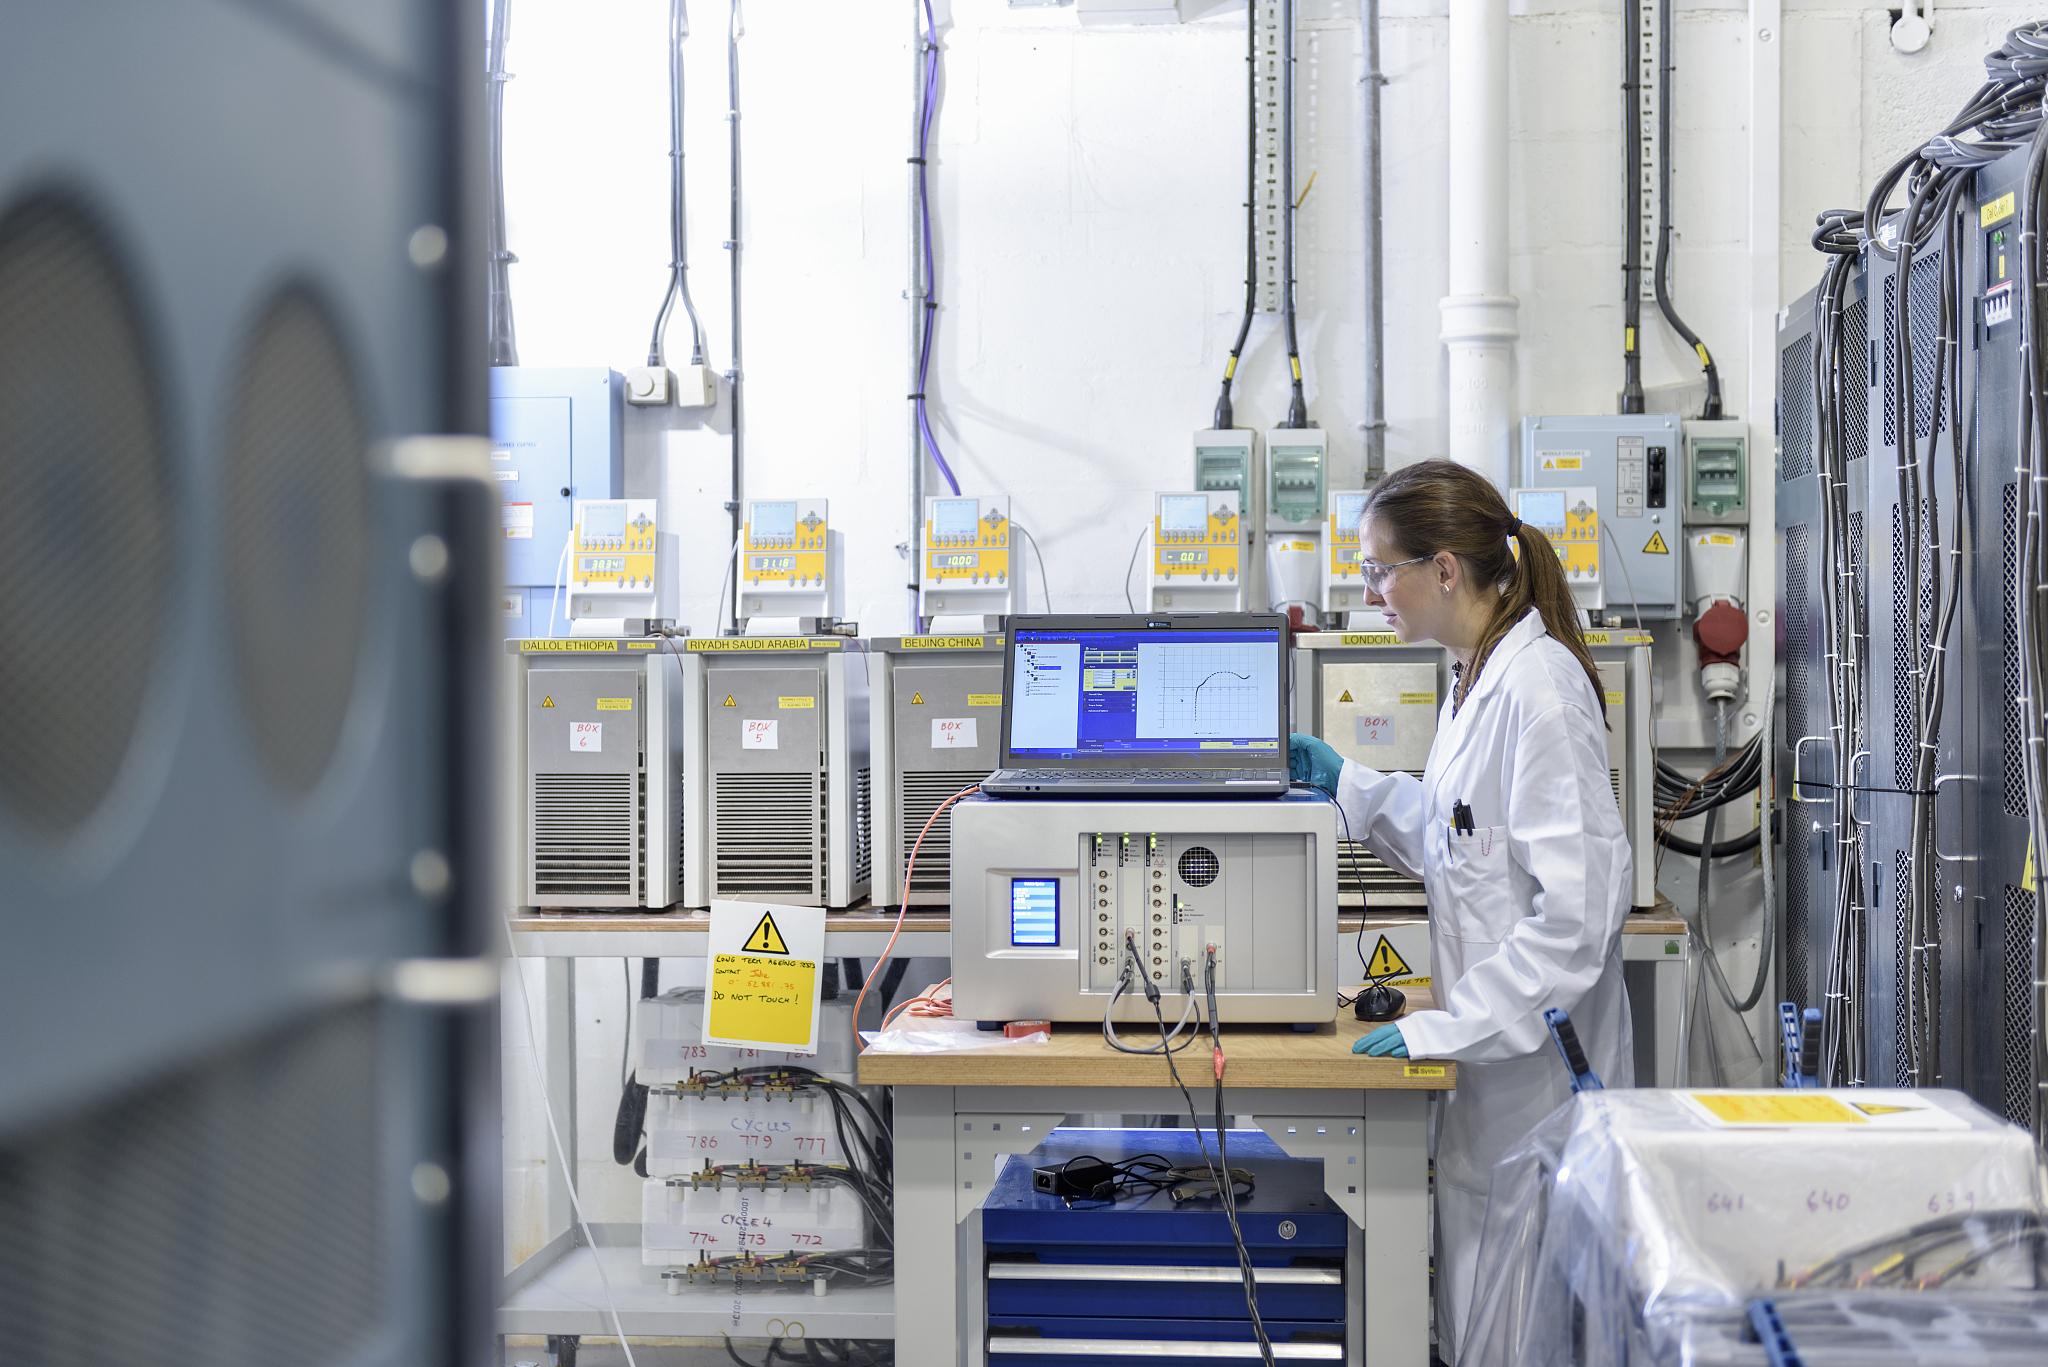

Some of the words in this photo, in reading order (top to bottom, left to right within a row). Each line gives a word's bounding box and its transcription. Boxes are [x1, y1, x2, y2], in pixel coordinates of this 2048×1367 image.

[690, 641, 729, 649] RIYADH
[732, 640, 765, 649] SAUDI
[768, 640, 806, 648] ARABIA
[905, 638, 945, 647] BEIJING
[948, 638, 982, 647] CHINA
[1344, 636, 1390, 644] LONDON
[523, 641, 562, 650] DALLOL
[565, 641, 614, 650] ETHIOPIA
[748, 721, 773, 732] BOX
[941, 722, 963, 730] BOX
[1364, 718, 1389, 727] BOX
[577, 723, 600, 733] BOX
[756, 734, 763, 742] 5
[947, 732, 955, 744] 4
[1371, 730, 1378, 740] 2
[580, 737, 586, 747] 6
[713, 991, 724, 1000] DO
[759, 995, 790, 1003] TOUCH
[681, 1046, 707, 1060] 783
[687, 1136, 717, 1148] 786
[739, 1135, 772, 1148] 779
[794, 1137, 826, 1155] 777
[1707, 1192, 1744, 1213] 641
[1806, 1189, 1850, 1213] 640
[1928, 1191, 1974, 1214] 639
[721, 1214, 760, 1227] CYCLE
[763, 1217, 773, 1227] 4
[689, 1232, 718, 1244] 774
[739, 1234, 766, 1245] 773
[791, 1234, 822, 1245] 772
